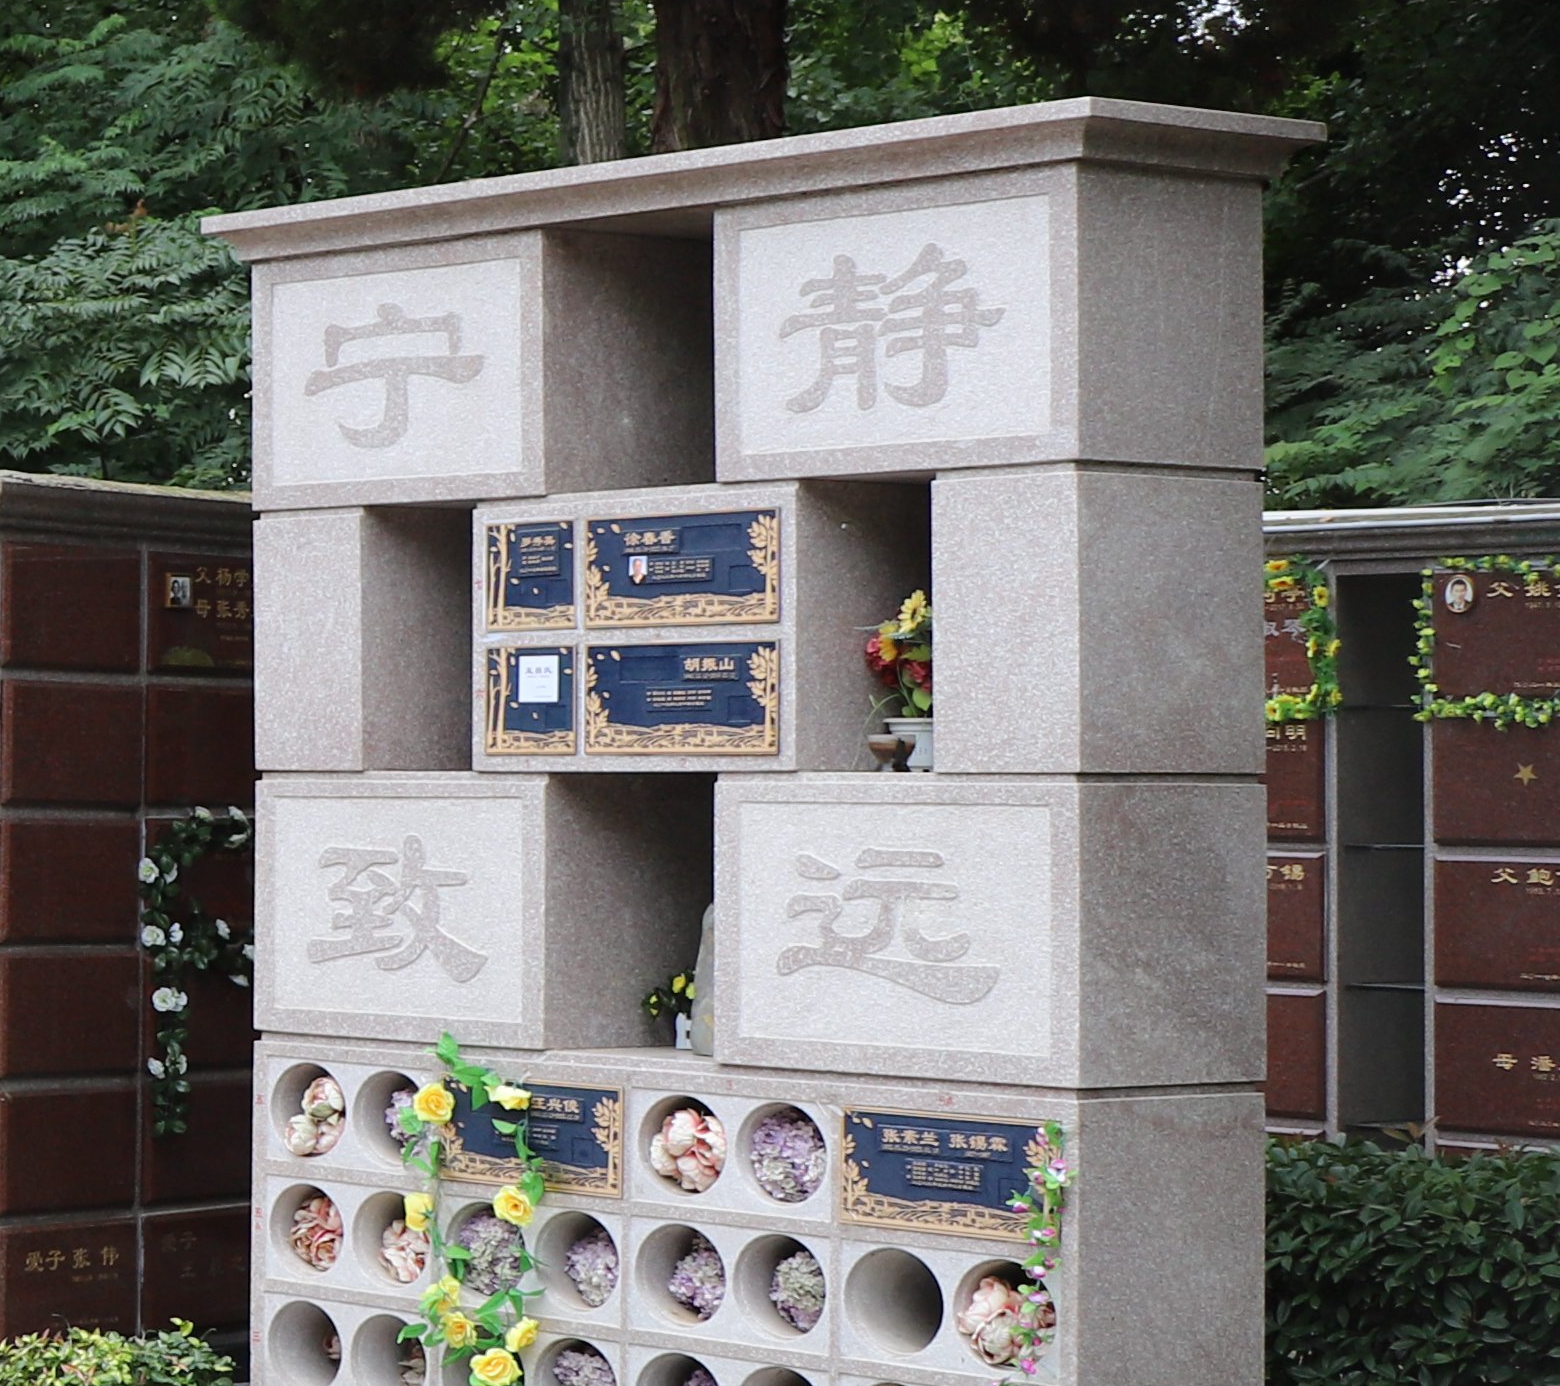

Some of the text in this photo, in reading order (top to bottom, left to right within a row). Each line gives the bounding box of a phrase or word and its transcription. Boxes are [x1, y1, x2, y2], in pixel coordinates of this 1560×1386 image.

[304, 243, 1005, 449] 宁 静
[308, 834, 1001, 1004] 致 远
